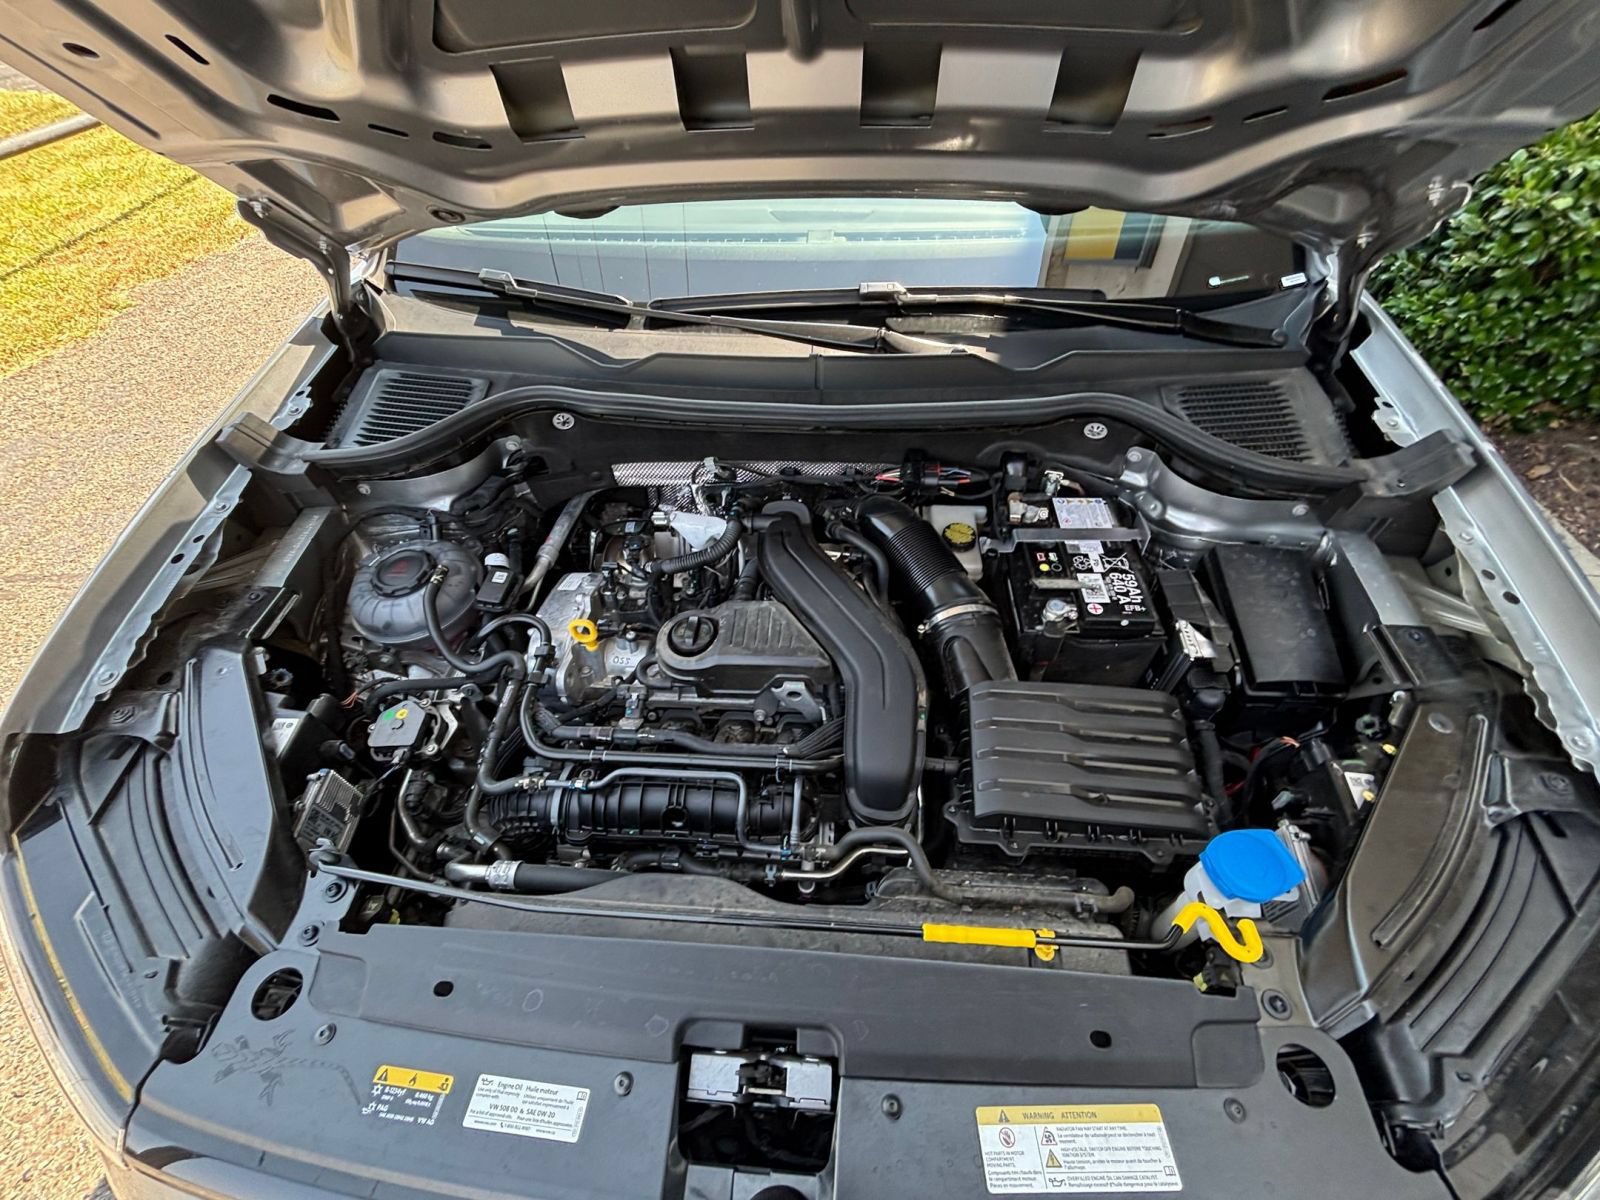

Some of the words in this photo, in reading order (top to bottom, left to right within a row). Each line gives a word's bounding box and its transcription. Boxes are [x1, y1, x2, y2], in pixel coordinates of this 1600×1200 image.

[1109, 572, 1127, 593] 640
[1122, 573, 1143, 603] 59Ah
[1116, 594, 1131, 604] A
[497, 1081, 515, 1090] Engine
[526, 1085, 540, 1093] Huile
[526, 1108, 537, 1116] SAE
[1022, 1111, 1055, 1120] WARNING
[1061, 1111, 1098, 1119] ATTENTION
